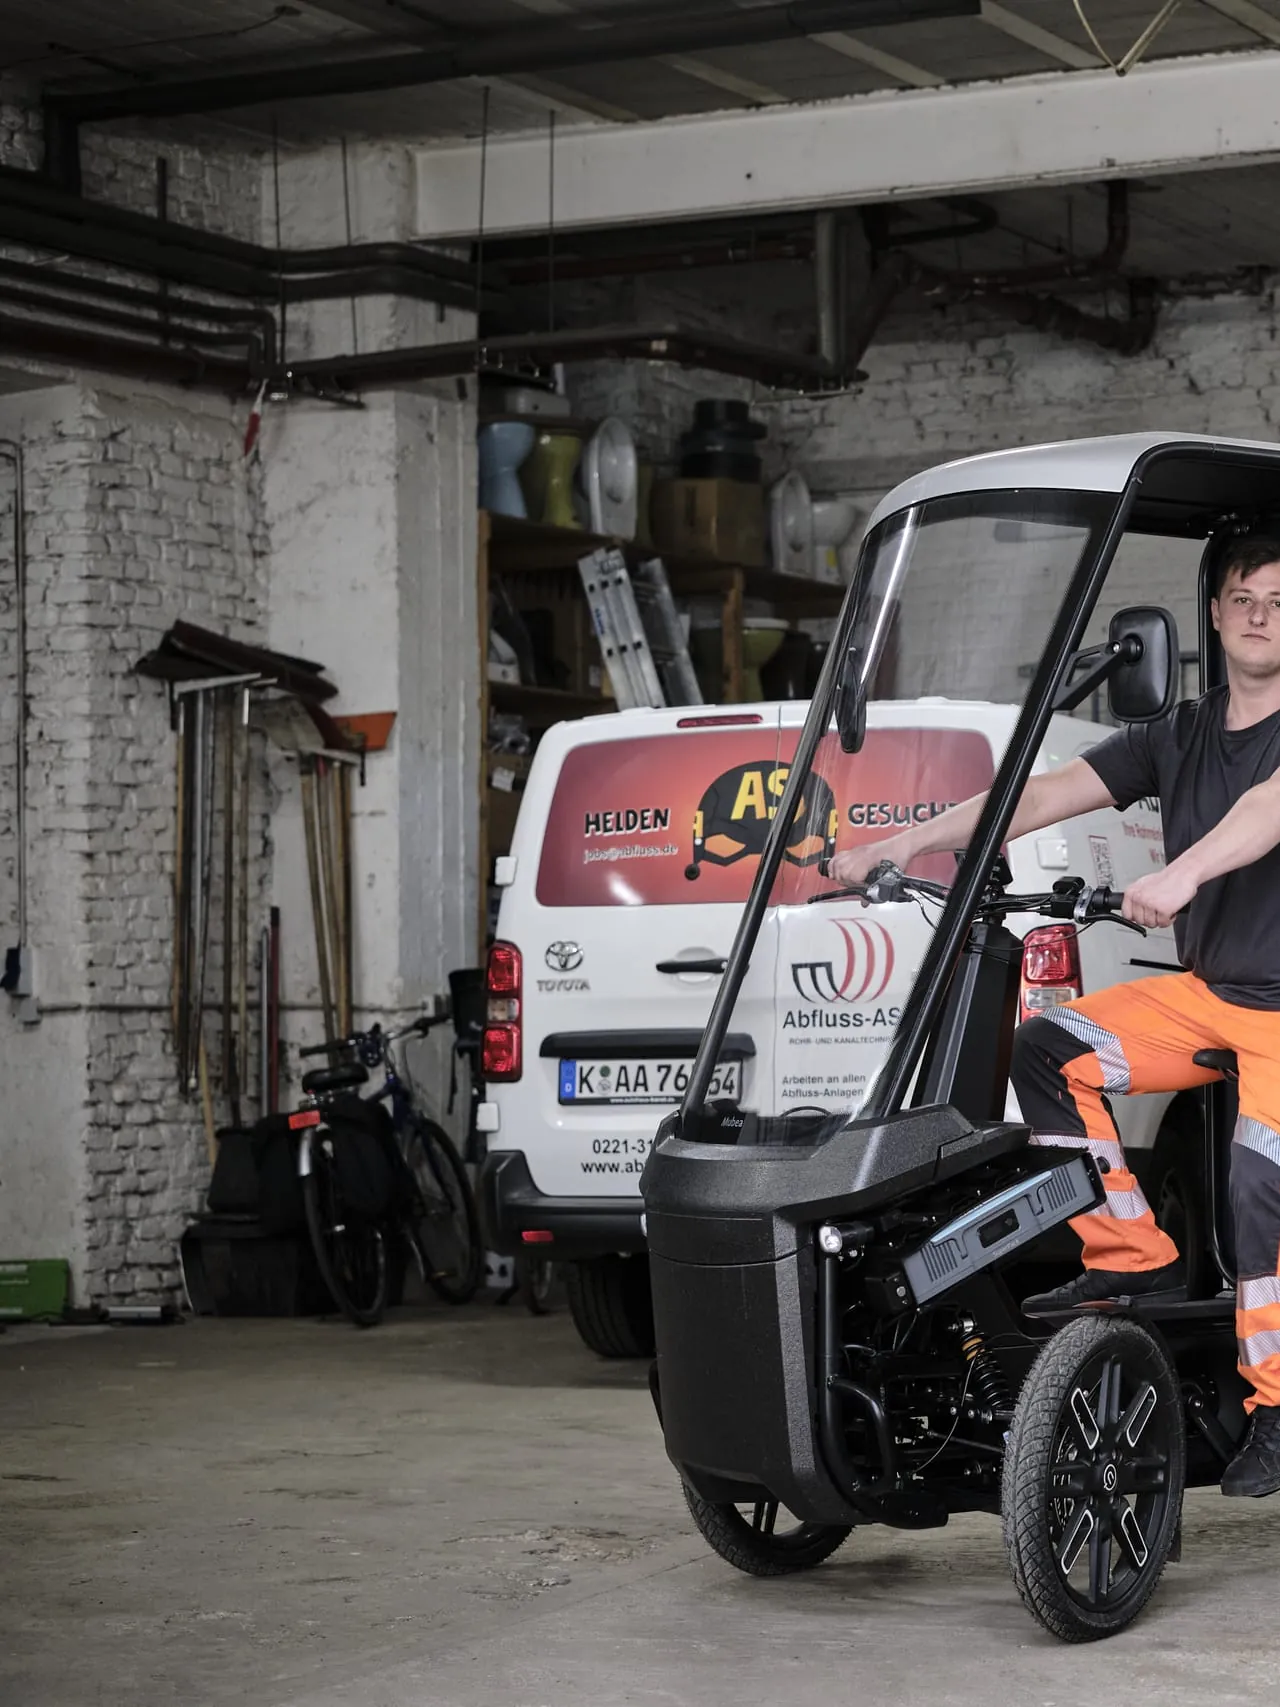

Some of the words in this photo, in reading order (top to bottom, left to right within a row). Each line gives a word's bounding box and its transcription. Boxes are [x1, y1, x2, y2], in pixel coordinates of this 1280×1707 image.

[584, 808, 670, 837] HELDEN
[847, 802, 958, 829] GESUCH
[536, 980, 591, 992] TOYOTA
[579, 1065, 595, 1094] K
[615, 1064, 649, 1093] AA
[782, 1075, 824, 1085] Arbeiten
[826, 1076, 838, 1084] an
[842, 1073, 866, 1083] allen
[782, 1087, 864, 1098] Abfluss-Anlagen
[720, 1116, 744, 1127] Mubea
[580, 1158, 645, 1173] www.ab
